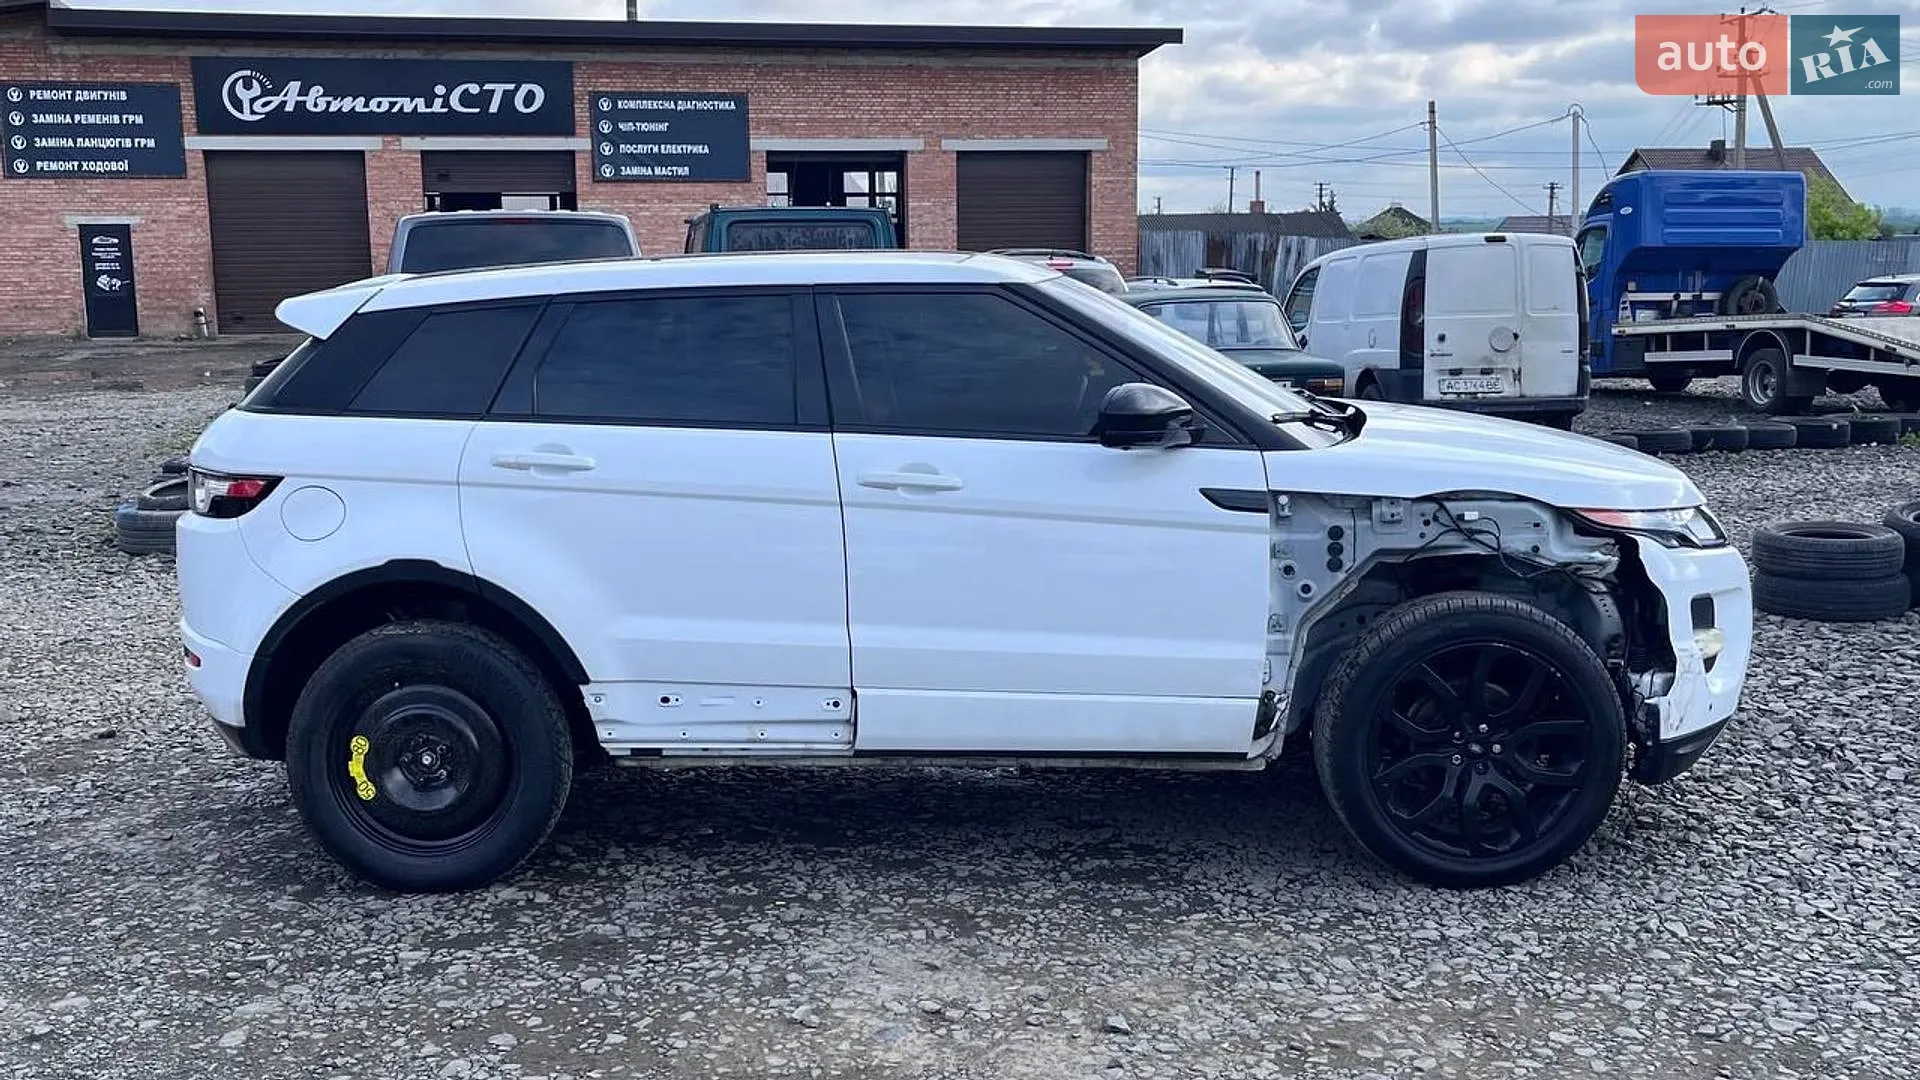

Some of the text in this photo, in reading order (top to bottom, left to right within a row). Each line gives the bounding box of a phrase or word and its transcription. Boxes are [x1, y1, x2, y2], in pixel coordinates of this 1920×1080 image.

[29, 90, 127, 101] РЕМОНТ ДВИГУНІВ
[617, 100, 736, 111] КОМПЛЕКСНА ДІАГНОСТИКА
[31, 114, 144, 124] ЗАМІНА РЕМЕНІВ ГРМ
[618, 122, 670, 132] ЧІП-ТЮНІНГ
[33, 137, 155, 149] ЗАМІНА ЛАНЦЮГІВ ГРМ
[619, 144, 709, 154] ПОСЛУГИ ЕЛЕКТРИКА
[36, 160, 129, 173] РЕМОНТ ХОДОВОЇ
[620, 166, 690, 176] ЗАМІНА МАСТИЛ
